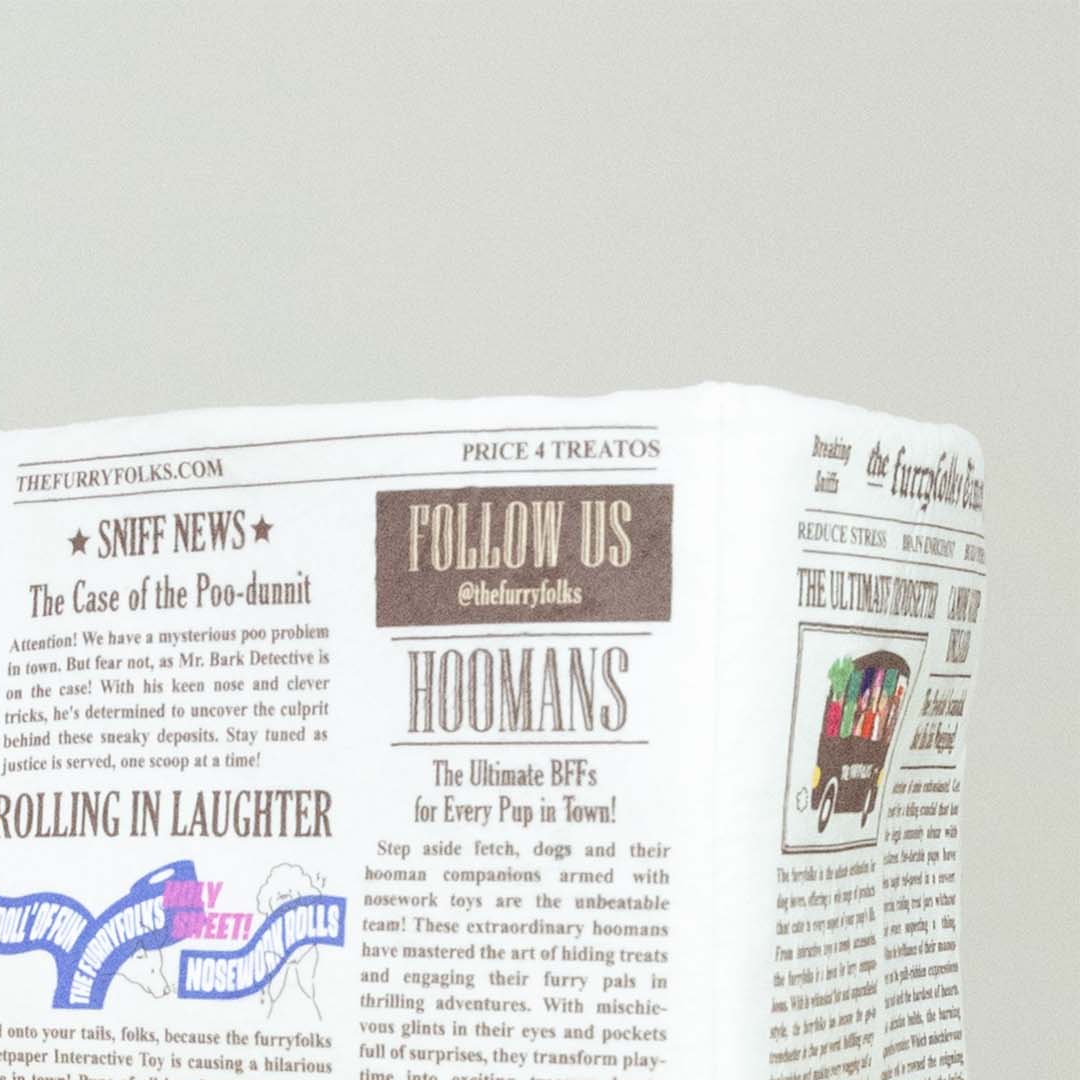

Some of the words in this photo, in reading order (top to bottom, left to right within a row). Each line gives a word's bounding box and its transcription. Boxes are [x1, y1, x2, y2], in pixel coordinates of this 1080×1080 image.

[461, 441, 529, 462] PRICE
[535, 442, 546, 460] 4
[551, 439, 662, 460] TREATOS
[812, 434, 852, 466] Breaking
[866, 441, 890, 478] the
[16, 459, 224, 492] THEFURRYFOLKS.COM
[98, 515, 167, 559] SNIFF
[173, 509, 246, 553] NEWS
[408, 500, 566, 572] FOLLOW
[580, 500, 633, 568] US
[797, 521, 848, 543] REDUCE
[850, 526, 888, 549] STRESS
[29, 584, 65, 618] The
[73, 579, 120, 614] Case
[128, 576, 150, 611] of
[155, 574, 187, 609] the
[195, 570, 312, 608] Poo-dunnit
[457, 578, 583, 609] @thefurryfolks
[797, 567, 826, 608] THE
[10, 632, 77, 653] Attention!
[82, 631, 103, 646] We
[108, 630, 141, 645] have
[146, 633, 153, 644] a
[159, 627, 236, 647] mysterious
[241, 628, 266, 645] poo
[271, 624, 330, 644] problem
[8, 662, 20, 676] in
[26, 662, 61, 675] town.
[66, 656, 90, 671] But
[95, 655, 123, 670] fear
[127, 656, 154, 672] not,
[159, 657, 173, 668] as
[179, 652, 204, 668] Mr.
[209, 650, 244, 667] Bark
[250, 650, 314, 666] Detective
[319, 649, 330, 664] is
[6, 689, 22, 700] on
[31, 683, 52, 698] the
[59, 680, 92, 696] case!
[101, 679, 134, 694] With
[143, 678, 163, 694] his
[172, 678, 205, 693] keen
[214, 680, 244, 692] nose
[252, 676, 279, 691] and
[287, 675, 330, 691] clever
[407, 646, 629, 733] HOOMANS
[433, 759, 464, 787] The
[470, 758, 545, 787] Ultimate
[551, 758, 598, 787] BFFs
[130, 790, 161, 837] IN
[171, 789, 333, 838] LAUGHTER
[414, 795, 438, 823] for
[444, 795, 492, 827] Every
[499, 795, 534, 828] Pup
[540, 798, 557, 823] in
[563, 795, 617, 824] Town!
[377, 840, 410, 860] Step
[423, 840, 462, 856] aside
[475, 840, 520, 858] fetch,
[533, 841, 572, 861] dogs
[585, 842, 615, 858] and
[630, 842, 671, 858] their
[365, 865, 426, 881] hooman
[443, 866, 541, 887] companions
[560, 868, 613, 884] armed
[633, 869, 669, 884] with
[163, 881, 223, 908] HOLY
[364, 892, 438, 907] nosework
[451, 894, 482, 912] toys
[496, 897, 522, 908] are
[536, 893, 562, 909] the
[575, 894, 670, 911] unbeatable
[29, 903, 59, 941] OF
[47, 907, 88, 952] FUN
[78, 896, 166, 976] FURRYFOLKS
[172, 911, 253, 940] SWEET!
[362, 916, 406, 932] team!
[413, 917, 459, 933] These
[466, 919, 584, 939] extraordinary
[592, 920, 668, 936] hoomans
[185, 916, 285, 993] NOSEWORK
[284, 904, 340, 949] DOLLS
[69, 971, 97, 1004] THE
[7, 1026, 38, 1039] onto
[42, 1028, 76, 1043] your
[81, 1026, 116, 1043] tails,
[121, 1026, 159, 1045] folks,
[165, 1028, 221, 1045] because
[226, 1030, 249, 1046] the
[254, 1030, 332, 1051] furryfolks
[54, 1048, 133, 1066] Interactive
[139, 1052, 165, 1072] Toy
[171, 1053, 182, 1068] is
[188, 1054, 244, 1075] causing
[248, 1060, 258, 1071] a
[264, 1056, 332, 1074] hilarious
